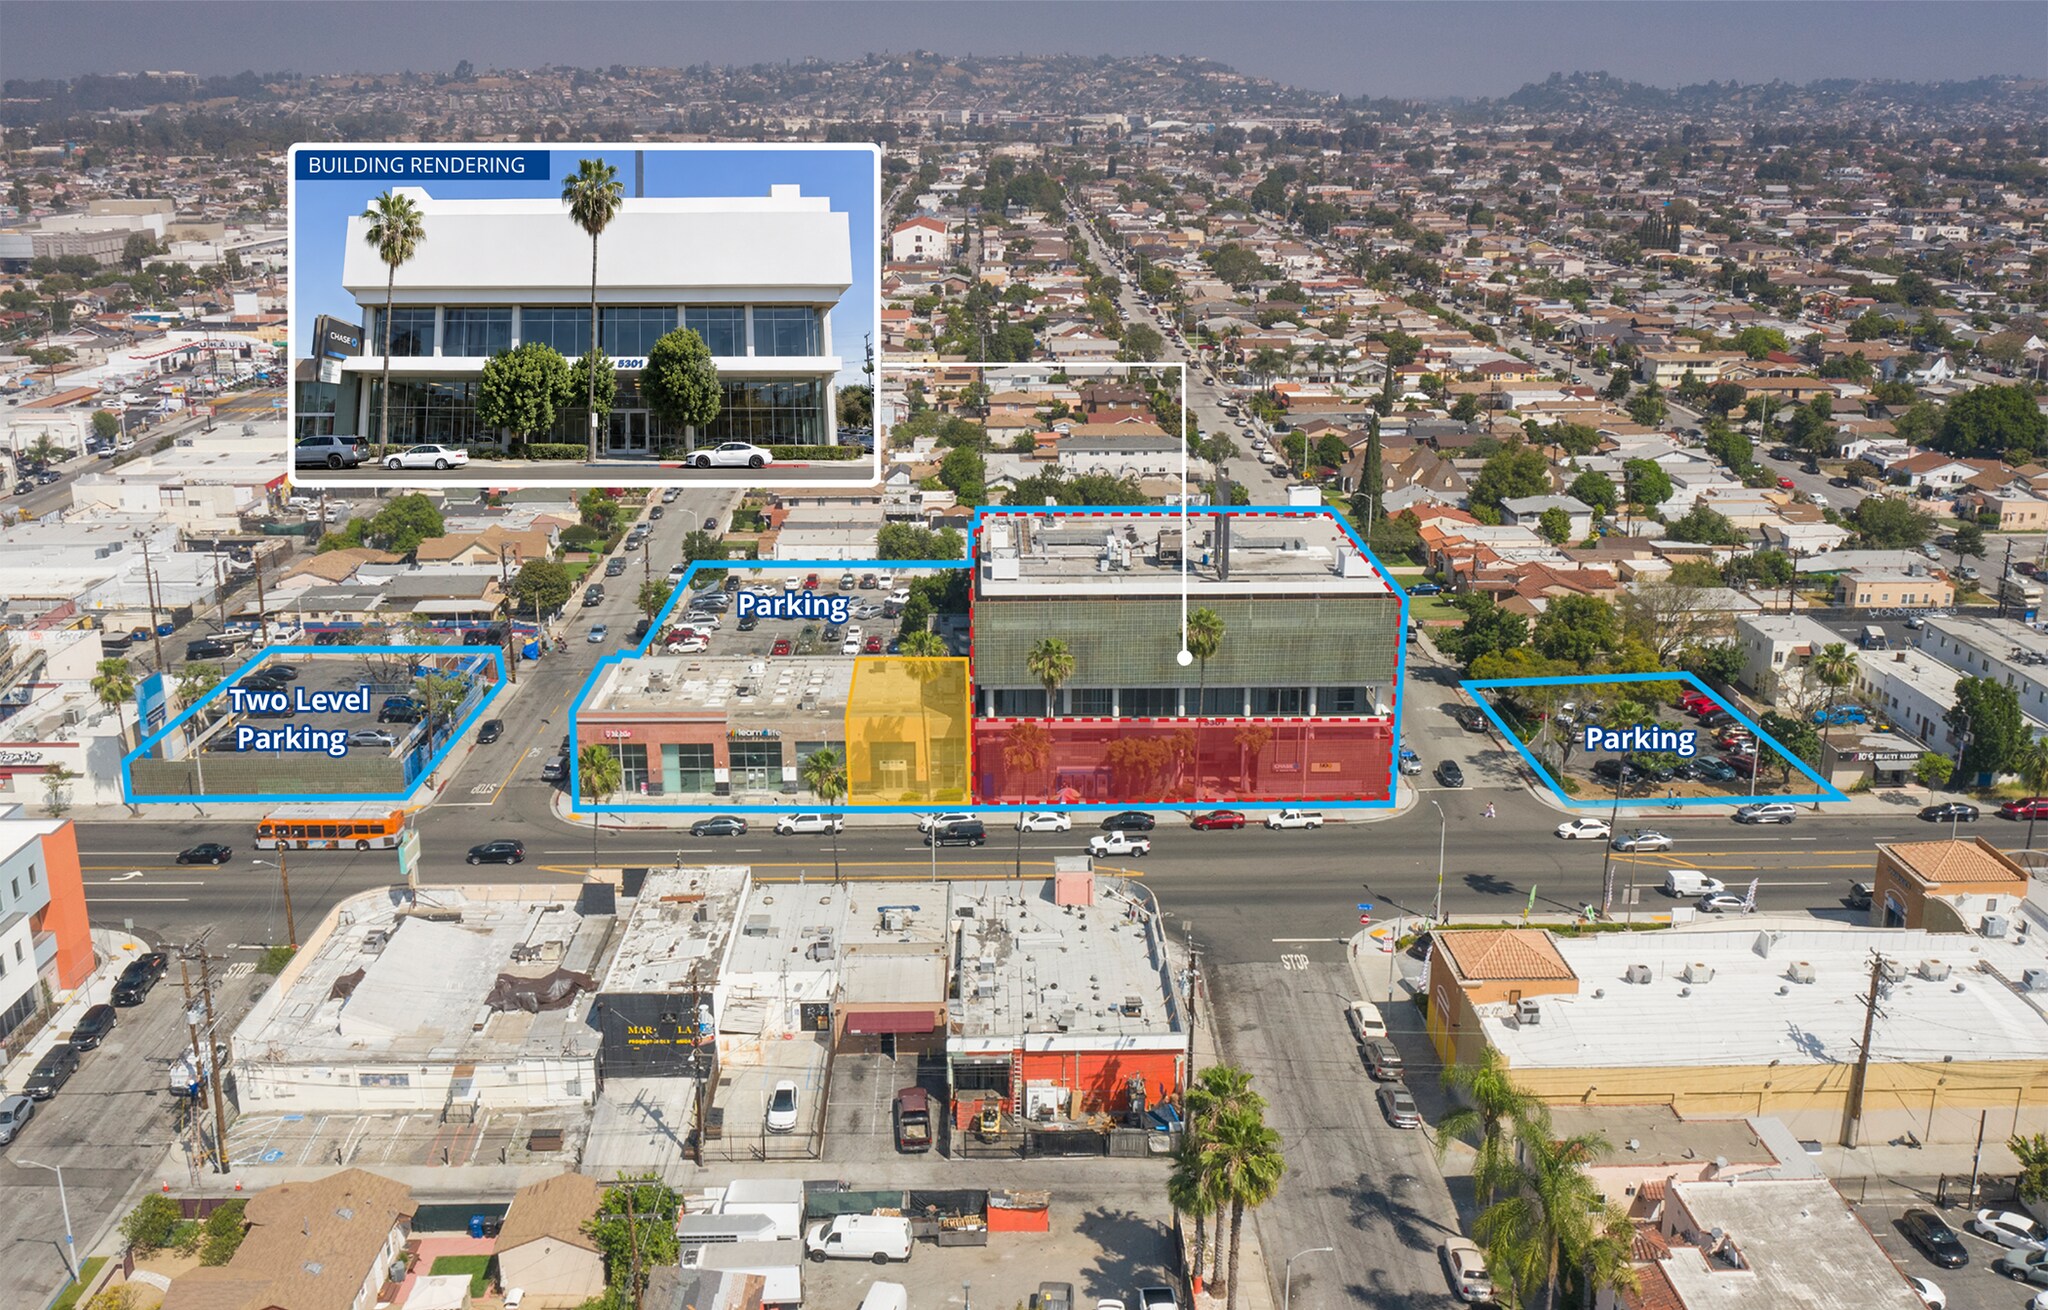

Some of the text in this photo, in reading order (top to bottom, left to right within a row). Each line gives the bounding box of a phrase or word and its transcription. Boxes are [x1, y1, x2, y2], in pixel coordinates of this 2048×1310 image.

[330, 332, 351, 345] CHASE
[617, 359, 643, 368] 5301
[471, 784, 496, 794] STOP
[1281, 954, 1309, 970] STOP
[222, 962, 258, 979] STOP
